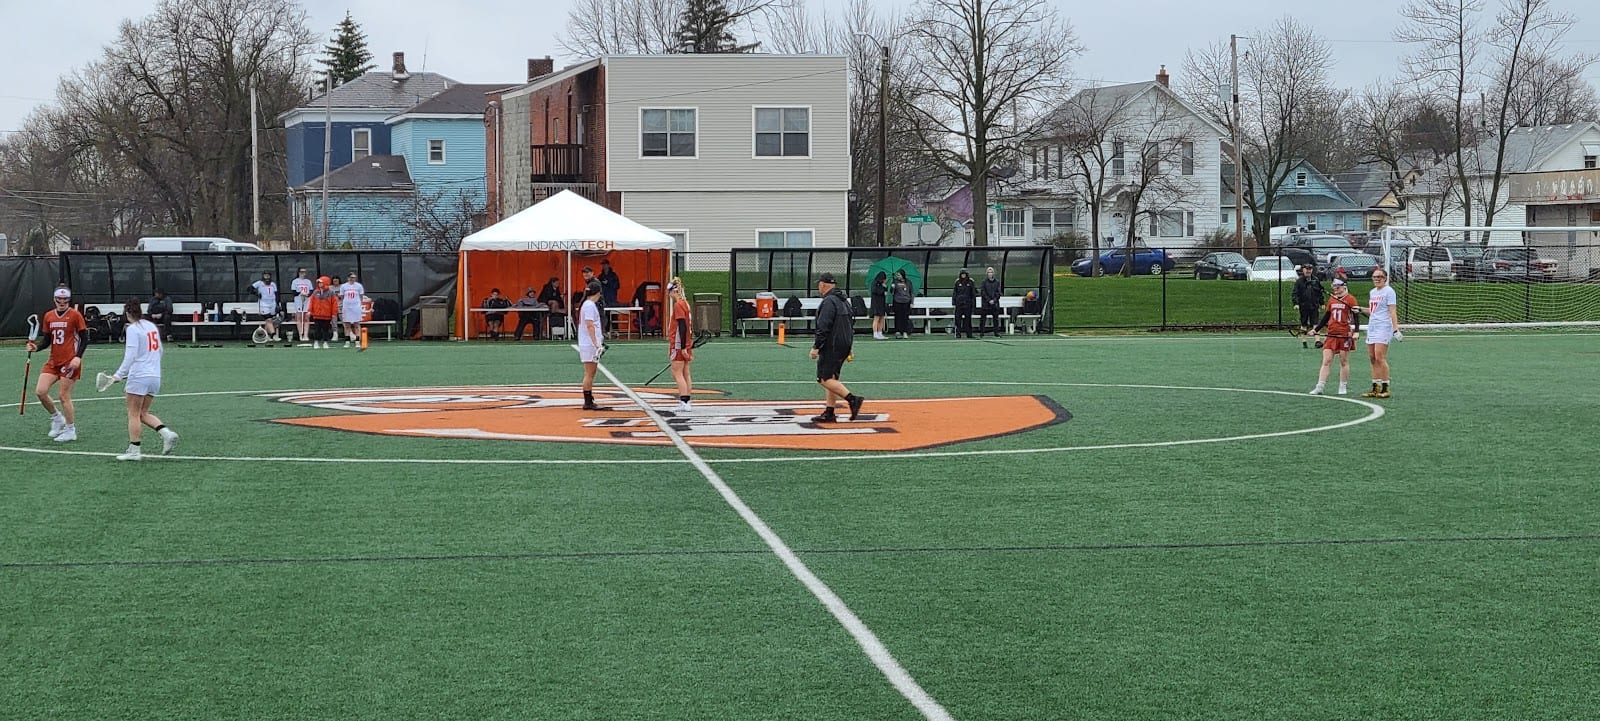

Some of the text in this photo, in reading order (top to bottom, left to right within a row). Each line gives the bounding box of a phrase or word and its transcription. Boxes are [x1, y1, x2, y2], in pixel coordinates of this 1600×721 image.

[527, 240, 614, 250] INDIANA TECH
[1331, 308, 1342, 322] 11
[51, 329, 65, 345] 13
[147, 331, 159, 352] 15
